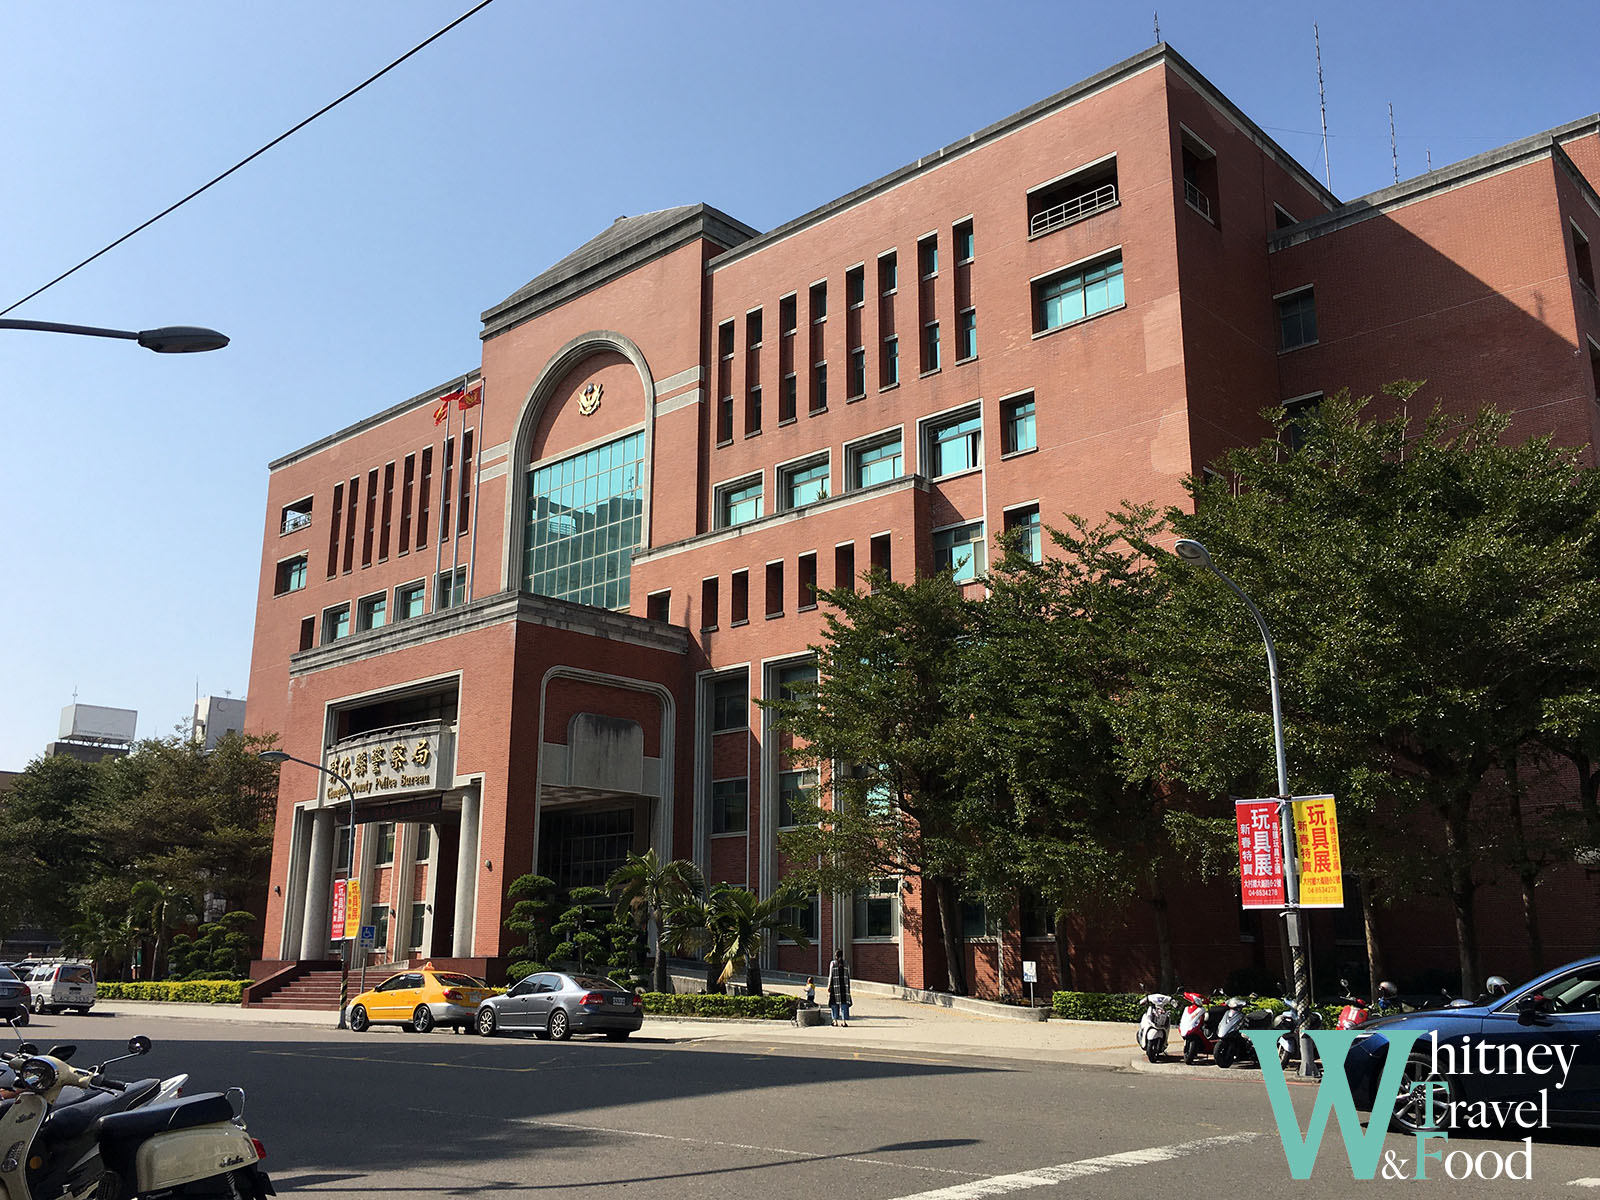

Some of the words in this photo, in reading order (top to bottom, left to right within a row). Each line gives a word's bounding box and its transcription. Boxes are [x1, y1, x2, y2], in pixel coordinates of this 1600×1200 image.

[352, 780, 373, 793] County
[375, 776, 397, 790] Police
[400, 774, 430, 788] Bureau
[1240, 823, 1253, 875] 新春特賣
[1250, 808, 1273, 876] 玩具展
[1297, 820, 1311, 873] 新春特賣
[1306, 804, 1331, 873] 玩具展
